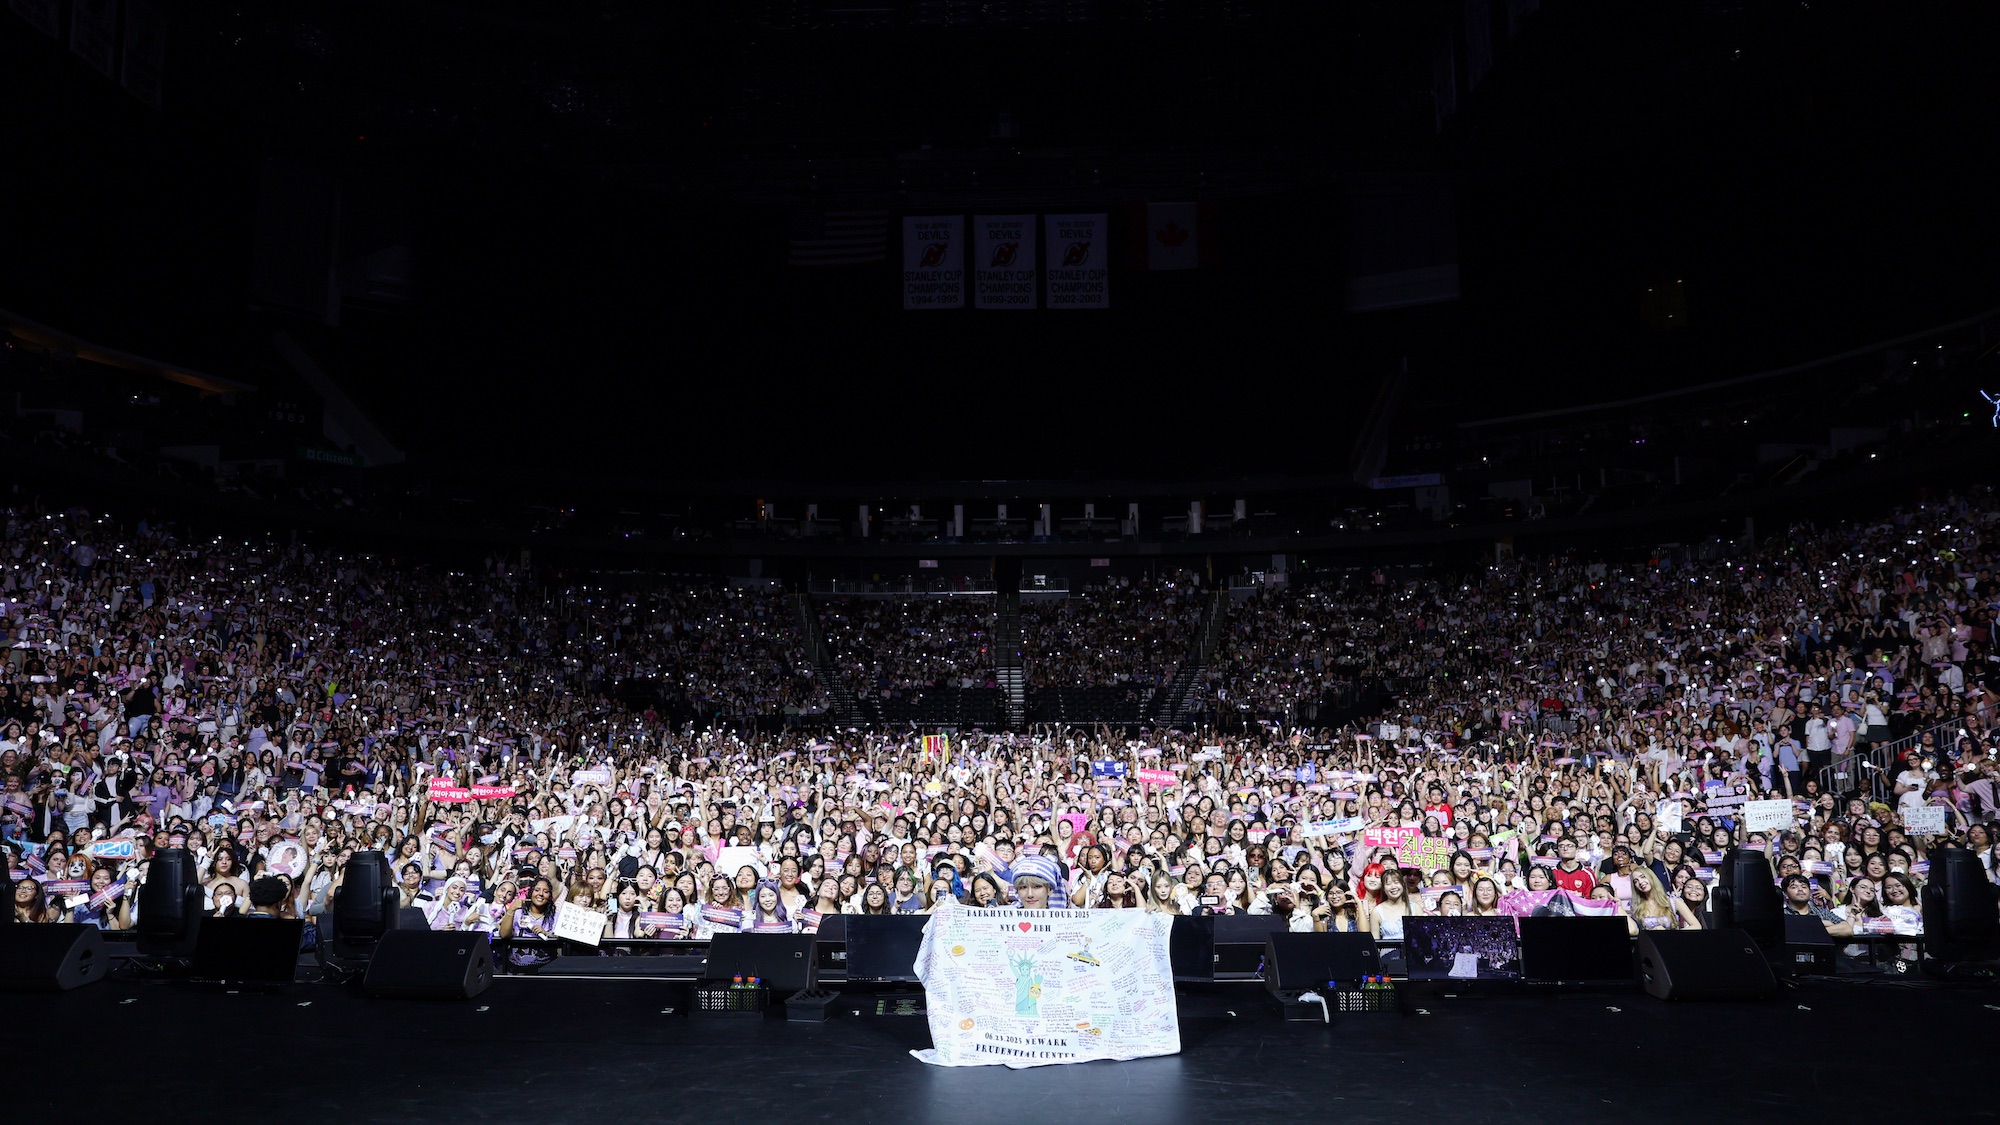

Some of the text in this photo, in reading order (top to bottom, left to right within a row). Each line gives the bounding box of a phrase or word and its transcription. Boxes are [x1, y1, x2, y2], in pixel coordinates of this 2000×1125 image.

[918, 231, 949, 240] DEVILS
[990, 230, 1021, 239] DEVILS
[1060, 229, 1092, 238] DEVILS
[905, 271, 962, 281] STANLEY CUP
[977, 271, 1034, 281] STANLEY CUP
[1050, 270, 1106, 280] STANLEY CUP
[908, 283, 960, 293] CHAMPIONS
[980, 283, 1032, 293] CHAMPIONS
[1052, 282, 1103, 293] CHAMPIONS
[911, 295, 958, 304] 1994-1995
[1053, 295, 1101, 303] 2002-2003
[269, 411, 305, 423] 1982
[316, 451, 354, 464] Citizens
[1401, 837, 1447, 854] 제 생일
[1400, 849, 1448, 869] 축하해줘
[985, 1032, 1022, 1044] 06.23.2025
[976, 1044, 1036, 1058] PRUDENTIAL
